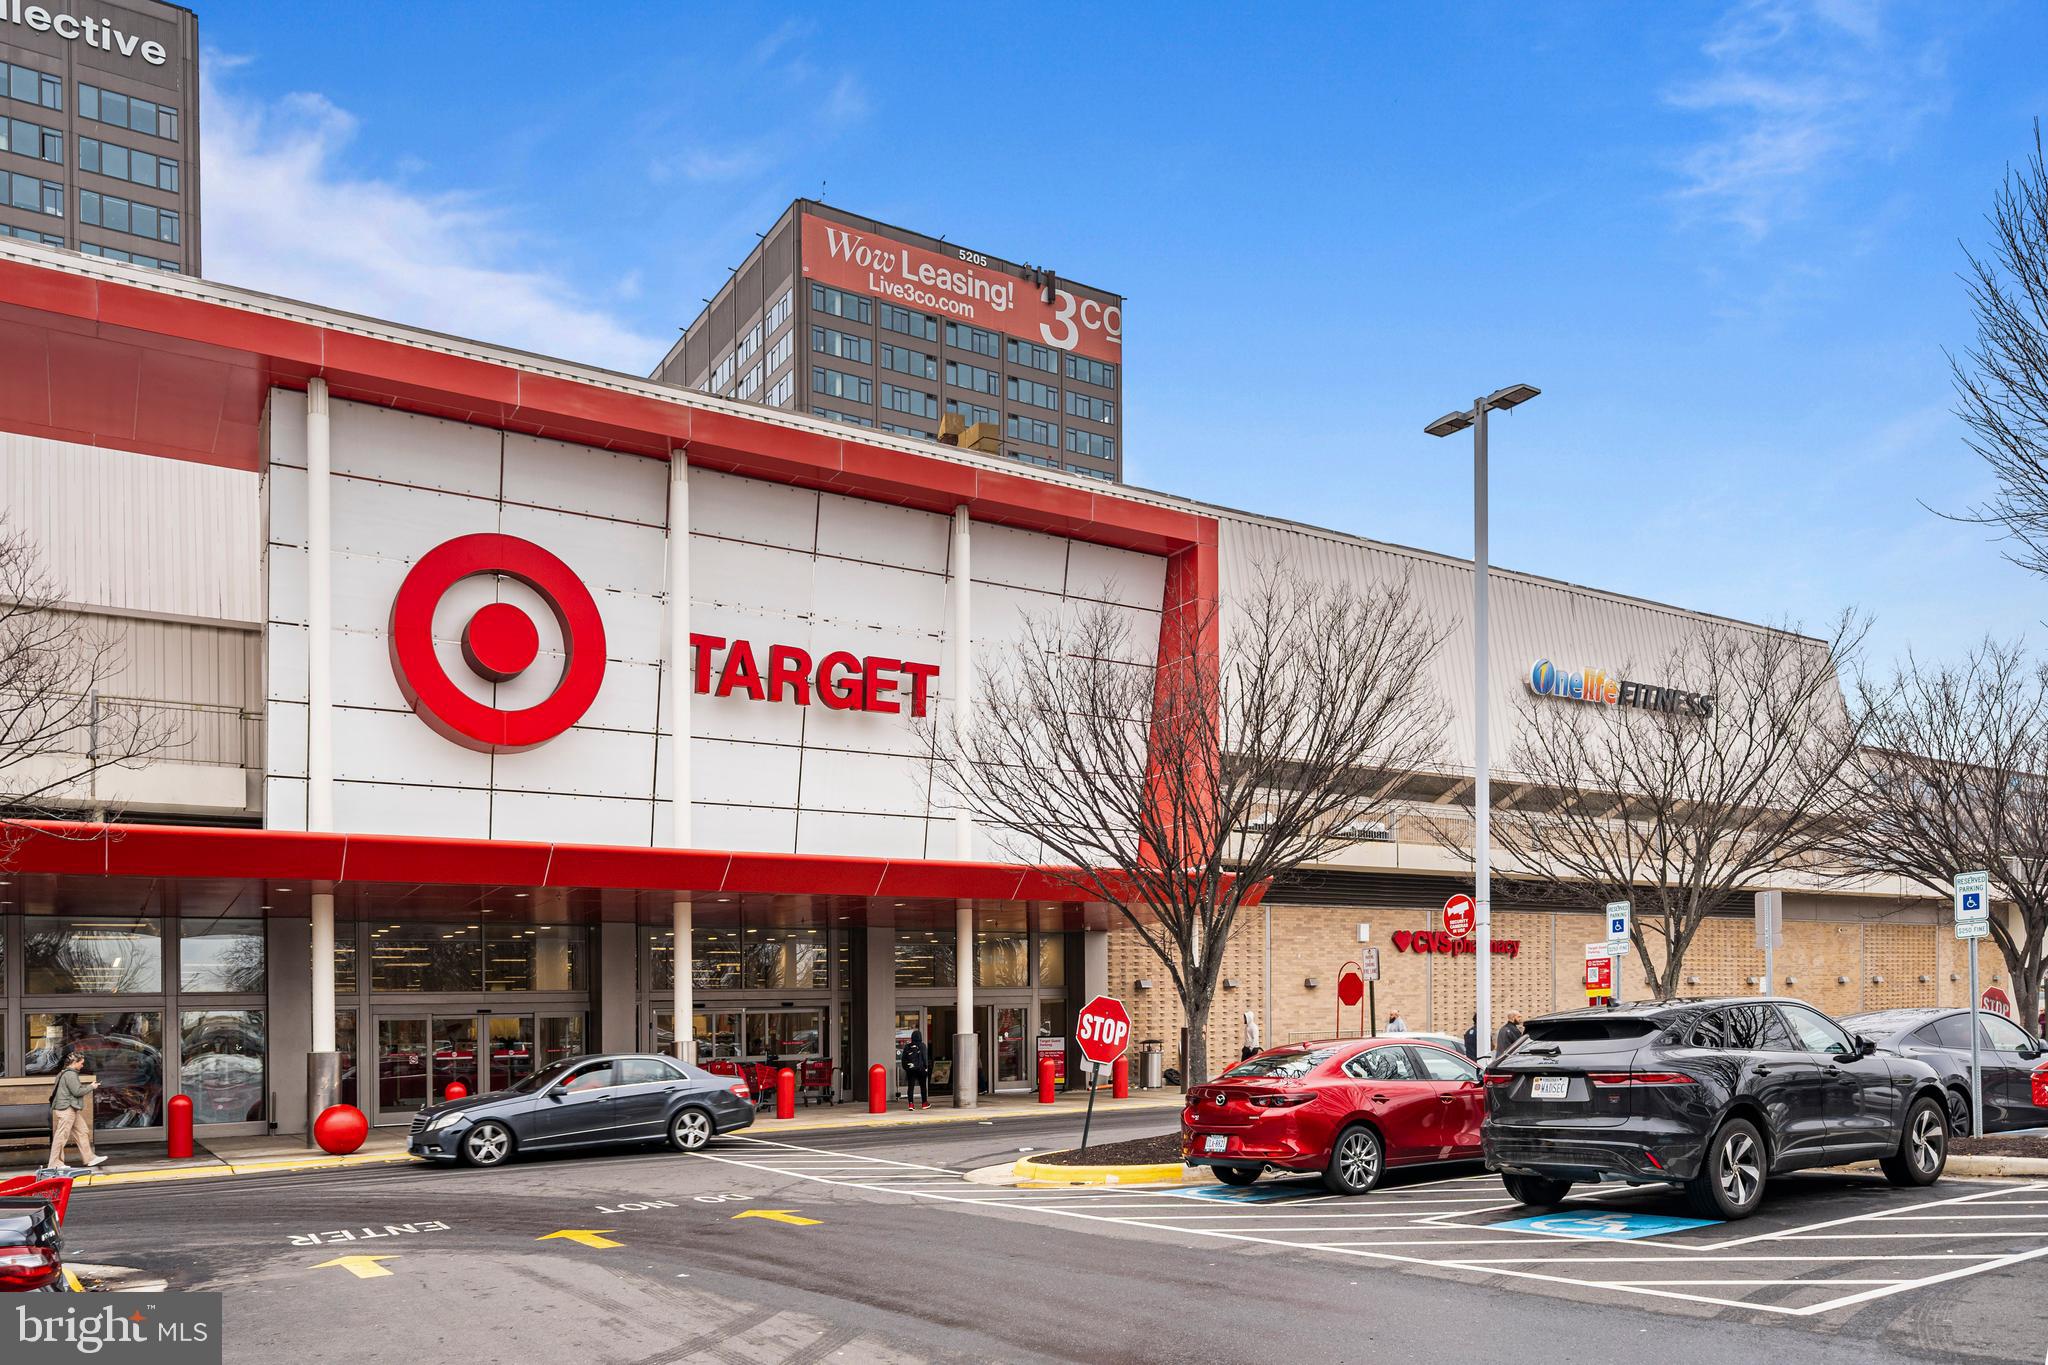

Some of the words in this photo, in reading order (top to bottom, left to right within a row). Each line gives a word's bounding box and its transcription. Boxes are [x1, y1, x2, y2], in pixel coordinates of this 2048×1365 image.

[825, 226, 896, 273] Wow
[902, 250, 1014, 312] Leasing!
[959, 249, 987, 267] 5205
[869, 272, 974, 318] Live3co.com
[690, 632, 940, 718] TARGET
[1531, 658, 1617, 705] Onelife
[1617, 680, 1715, 720] FITNESS
[1957, 876, 1986, 885] RESERVED
[1959, 884, 1984, 893] PARKING
[1412, 931, 1452, 954] CVS
[1983, 997, 2009, 1016] STOP
[1080, 1013, 1127, 1046] STOP
[595, 1200, 679, 1214] NOT
[693, 1193, 754, 1203] DO
[286, 1220, 451, 1246] ENTER
